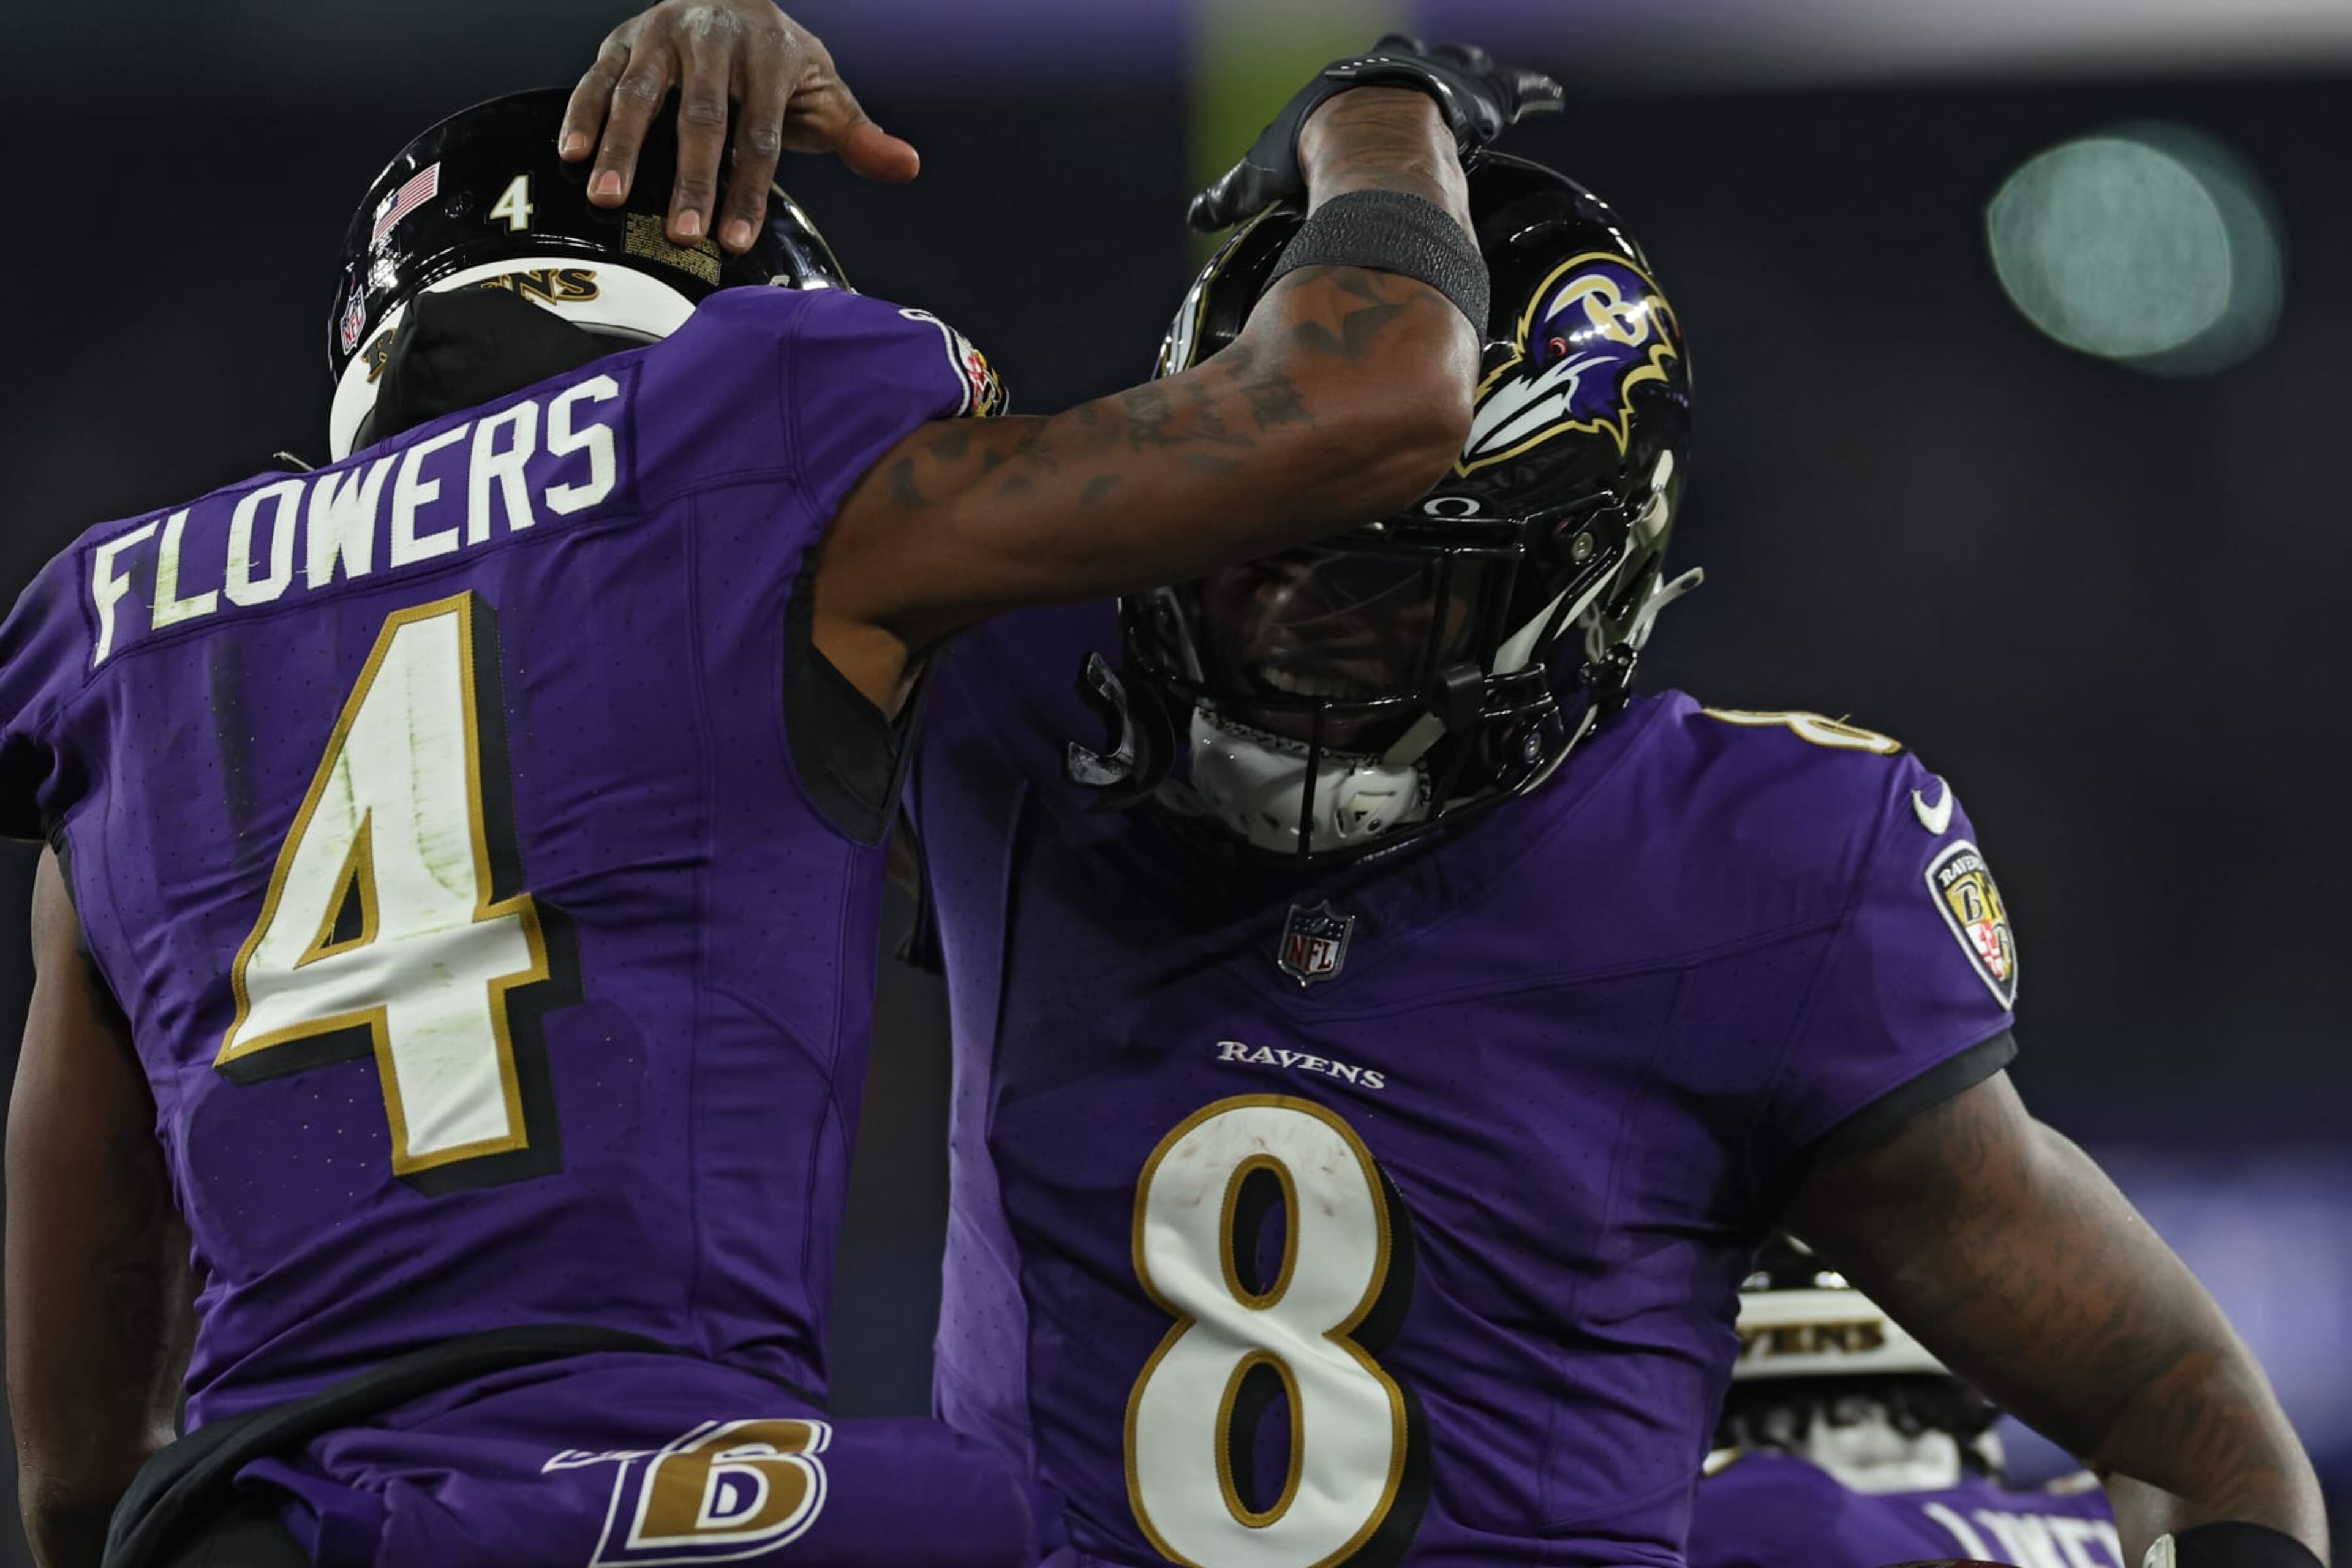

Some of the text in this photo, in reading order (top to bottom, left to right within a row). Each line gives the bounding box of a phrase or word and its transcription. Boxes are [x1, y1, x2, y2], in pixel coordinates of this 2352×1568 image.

[490, 173, 533, 230] 4
[480, 267, 600, 306] NS
[92, 374, 619, 668] FLOWERS
[213, 590, 551, 1176] 4
[1289, 935, 1333, 973] NFL
[1216, 1040, 1386, 1090] RAVENS
[1123, 1094, 1408, 1568] 8
